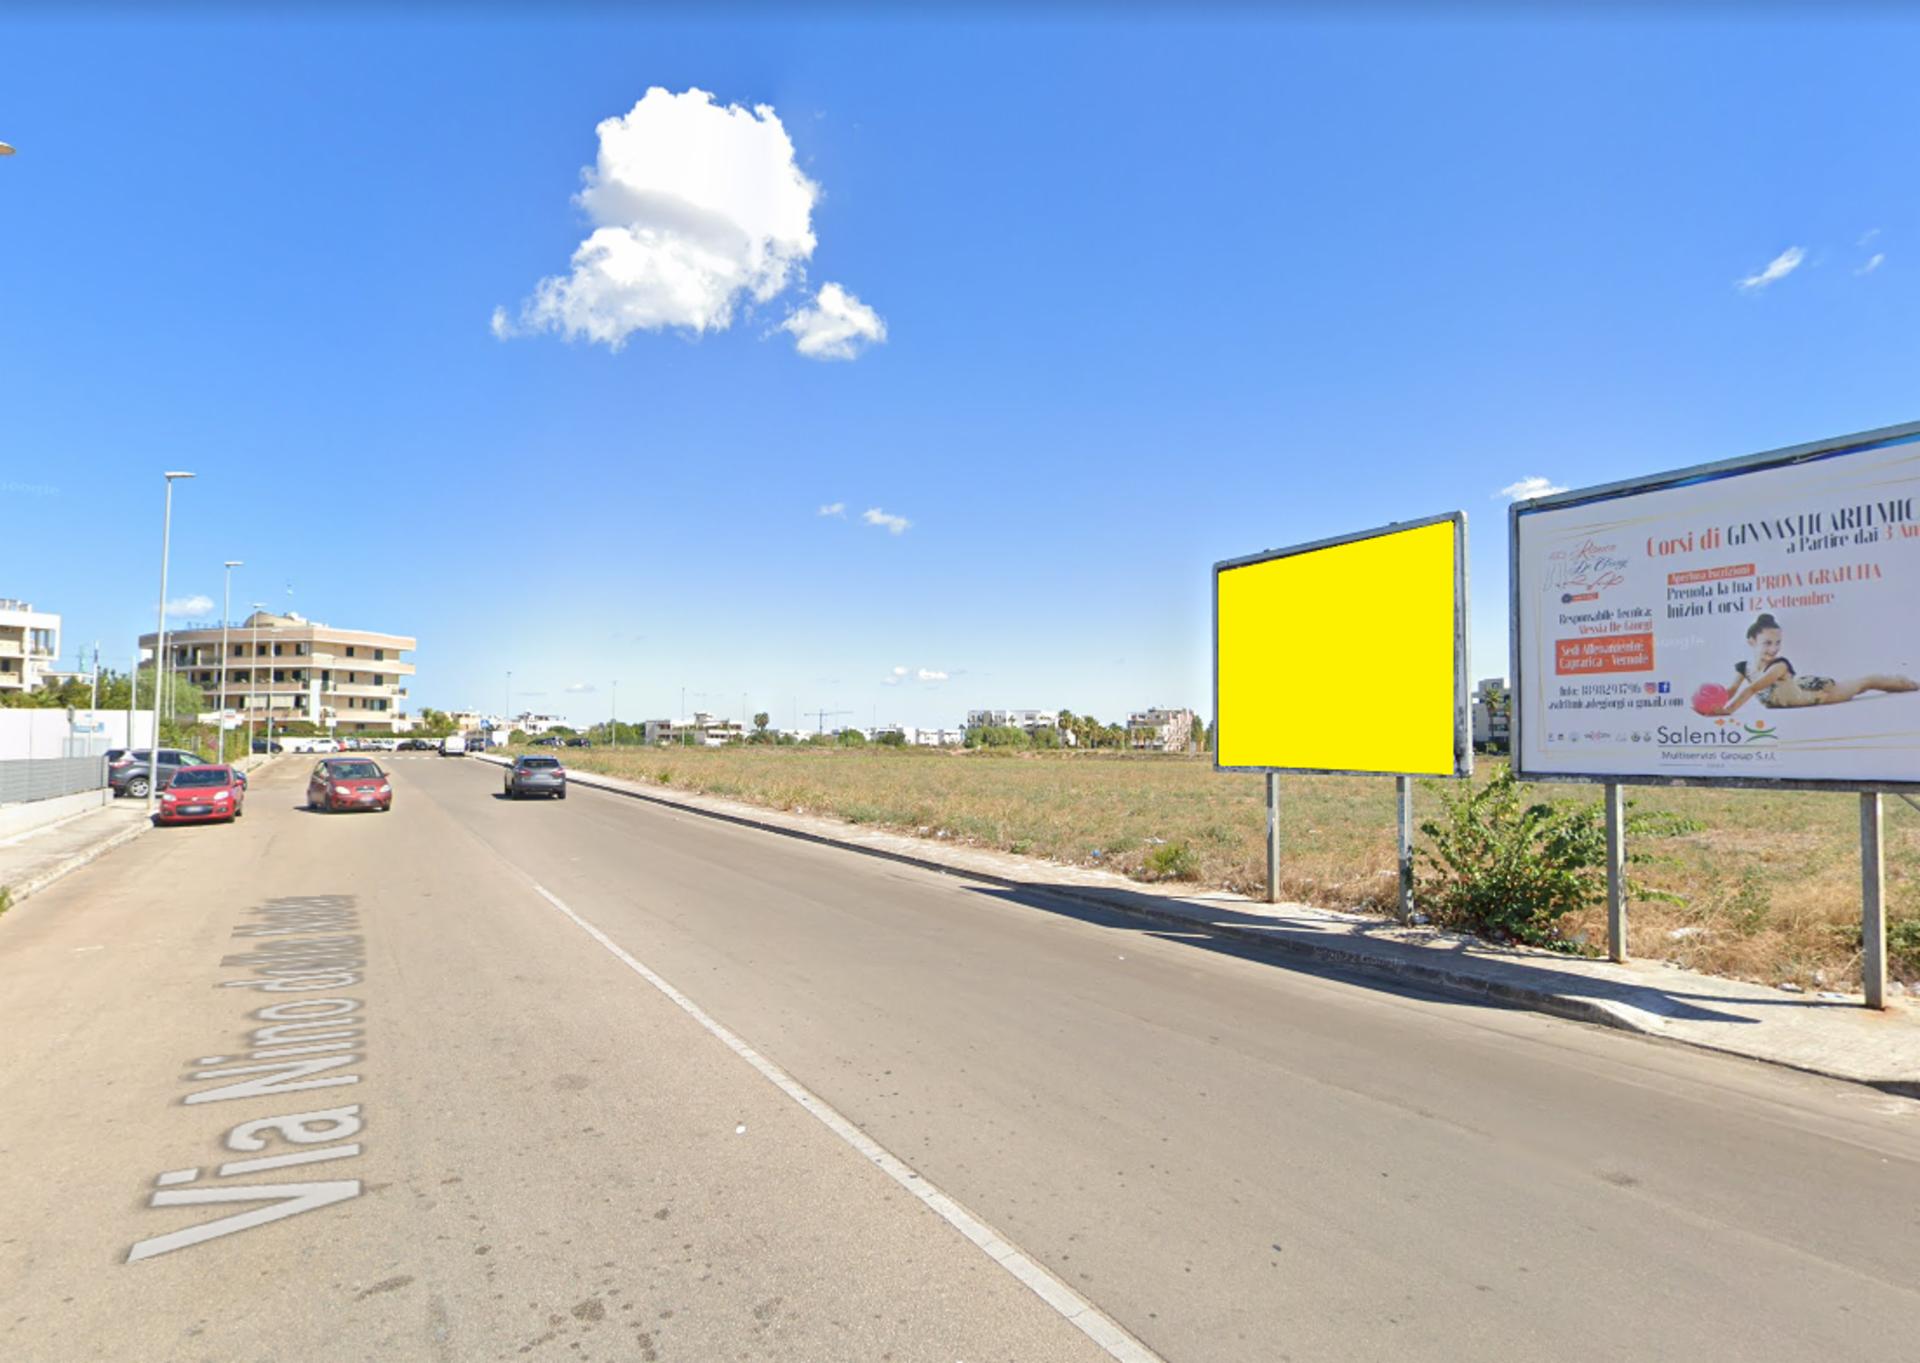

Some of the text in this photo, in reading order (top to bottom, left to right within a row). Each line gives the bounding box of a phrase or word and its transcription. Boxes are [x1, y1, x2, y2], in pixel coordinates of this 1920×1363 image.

[1646, 531, 1693, 557] Corsi
[1700, 527, 1720, 550] di
[1786, 542, 1796, 554] a
[1799, 532, 1850, 552] Partire
[1854, 527, 1879, 545] dai
[1900, 523, 1920, 538] An
[1667, 563, 1883, 601] Prenota la tua PROVA GRATUITA
[1667, 591, 1836, 619] Inizio Corsi 12 Settembre
[1656, 725, 1742, 744] Salento
[1661, 751, 1717, 761] Multiservizi
[1720, 751, 1754, 762] Group
